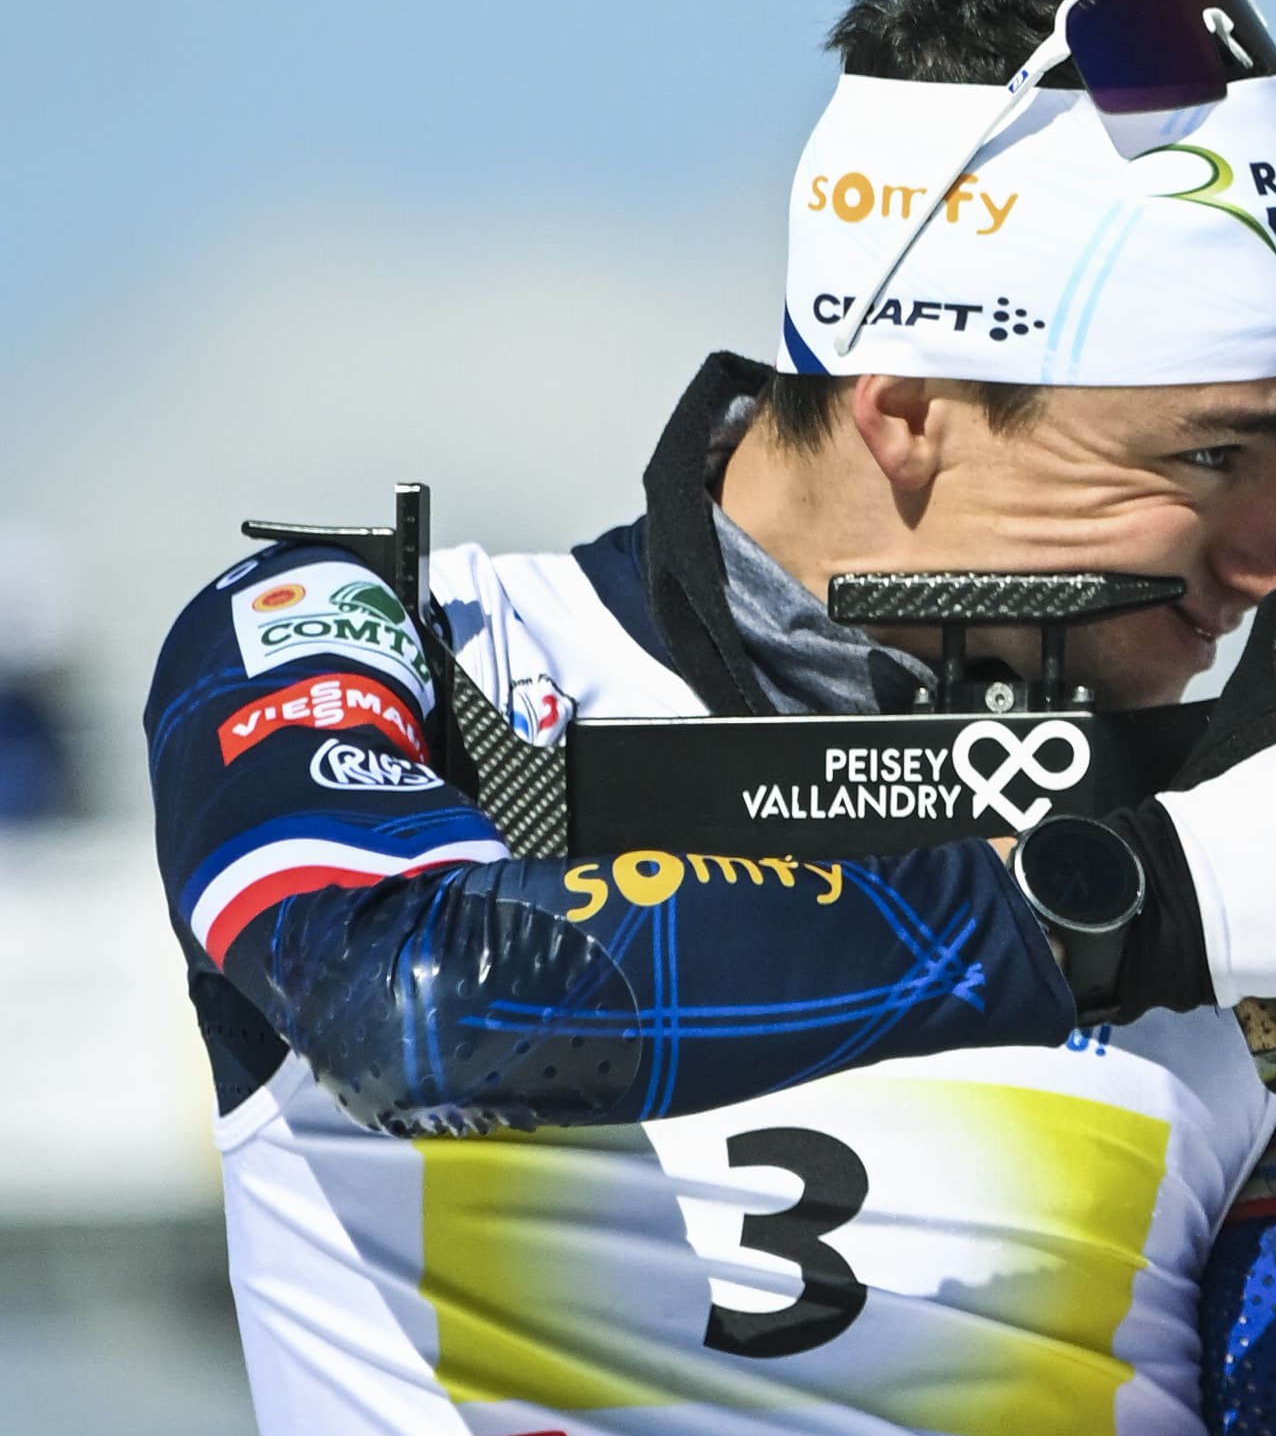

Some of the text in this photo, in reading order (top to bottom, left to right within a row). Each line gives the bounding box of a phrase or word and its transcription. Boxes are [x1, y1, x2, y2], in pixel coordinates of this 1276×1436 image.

[825, 748, 948, 782] PEISEY
[742, 784, 962, 819] VALLANDRY
[703, 1126, 869, 1360] 3
